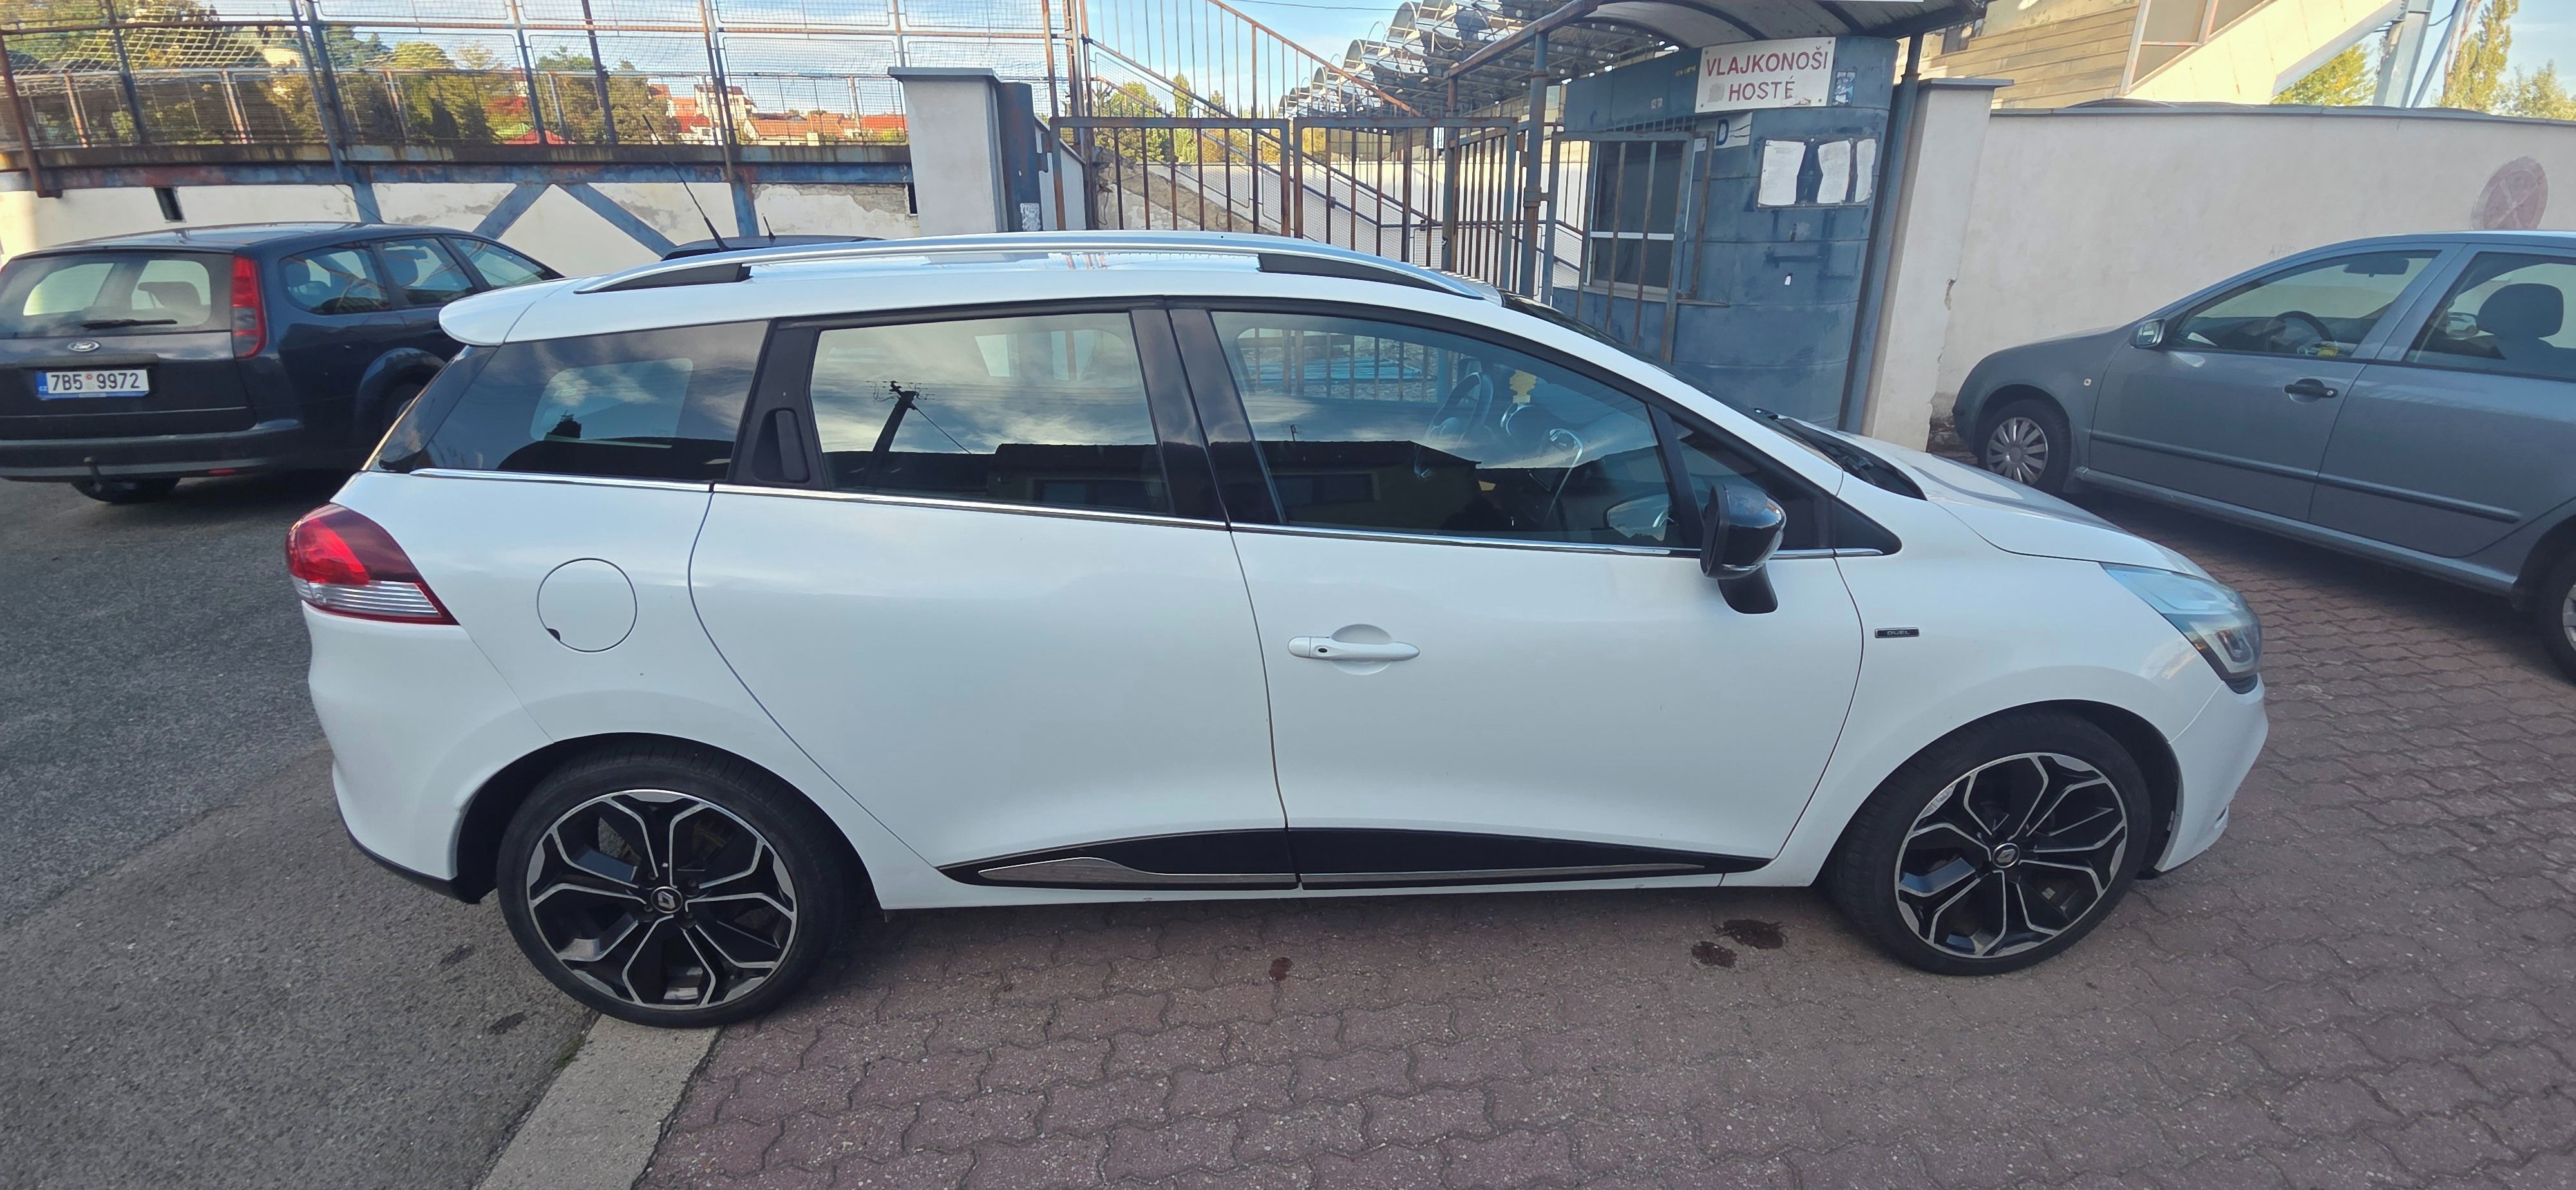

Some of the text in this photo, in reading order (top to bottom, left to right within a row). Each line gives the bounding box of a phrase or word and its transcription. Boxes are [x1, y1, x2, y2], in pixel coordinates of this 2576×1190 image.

[1707, 46, 1828, 77] VLAJKONOŠI
[1728, 75, 1795, 102] HOSTÉ
[51, 372, 140, 391] 7B5 9972
